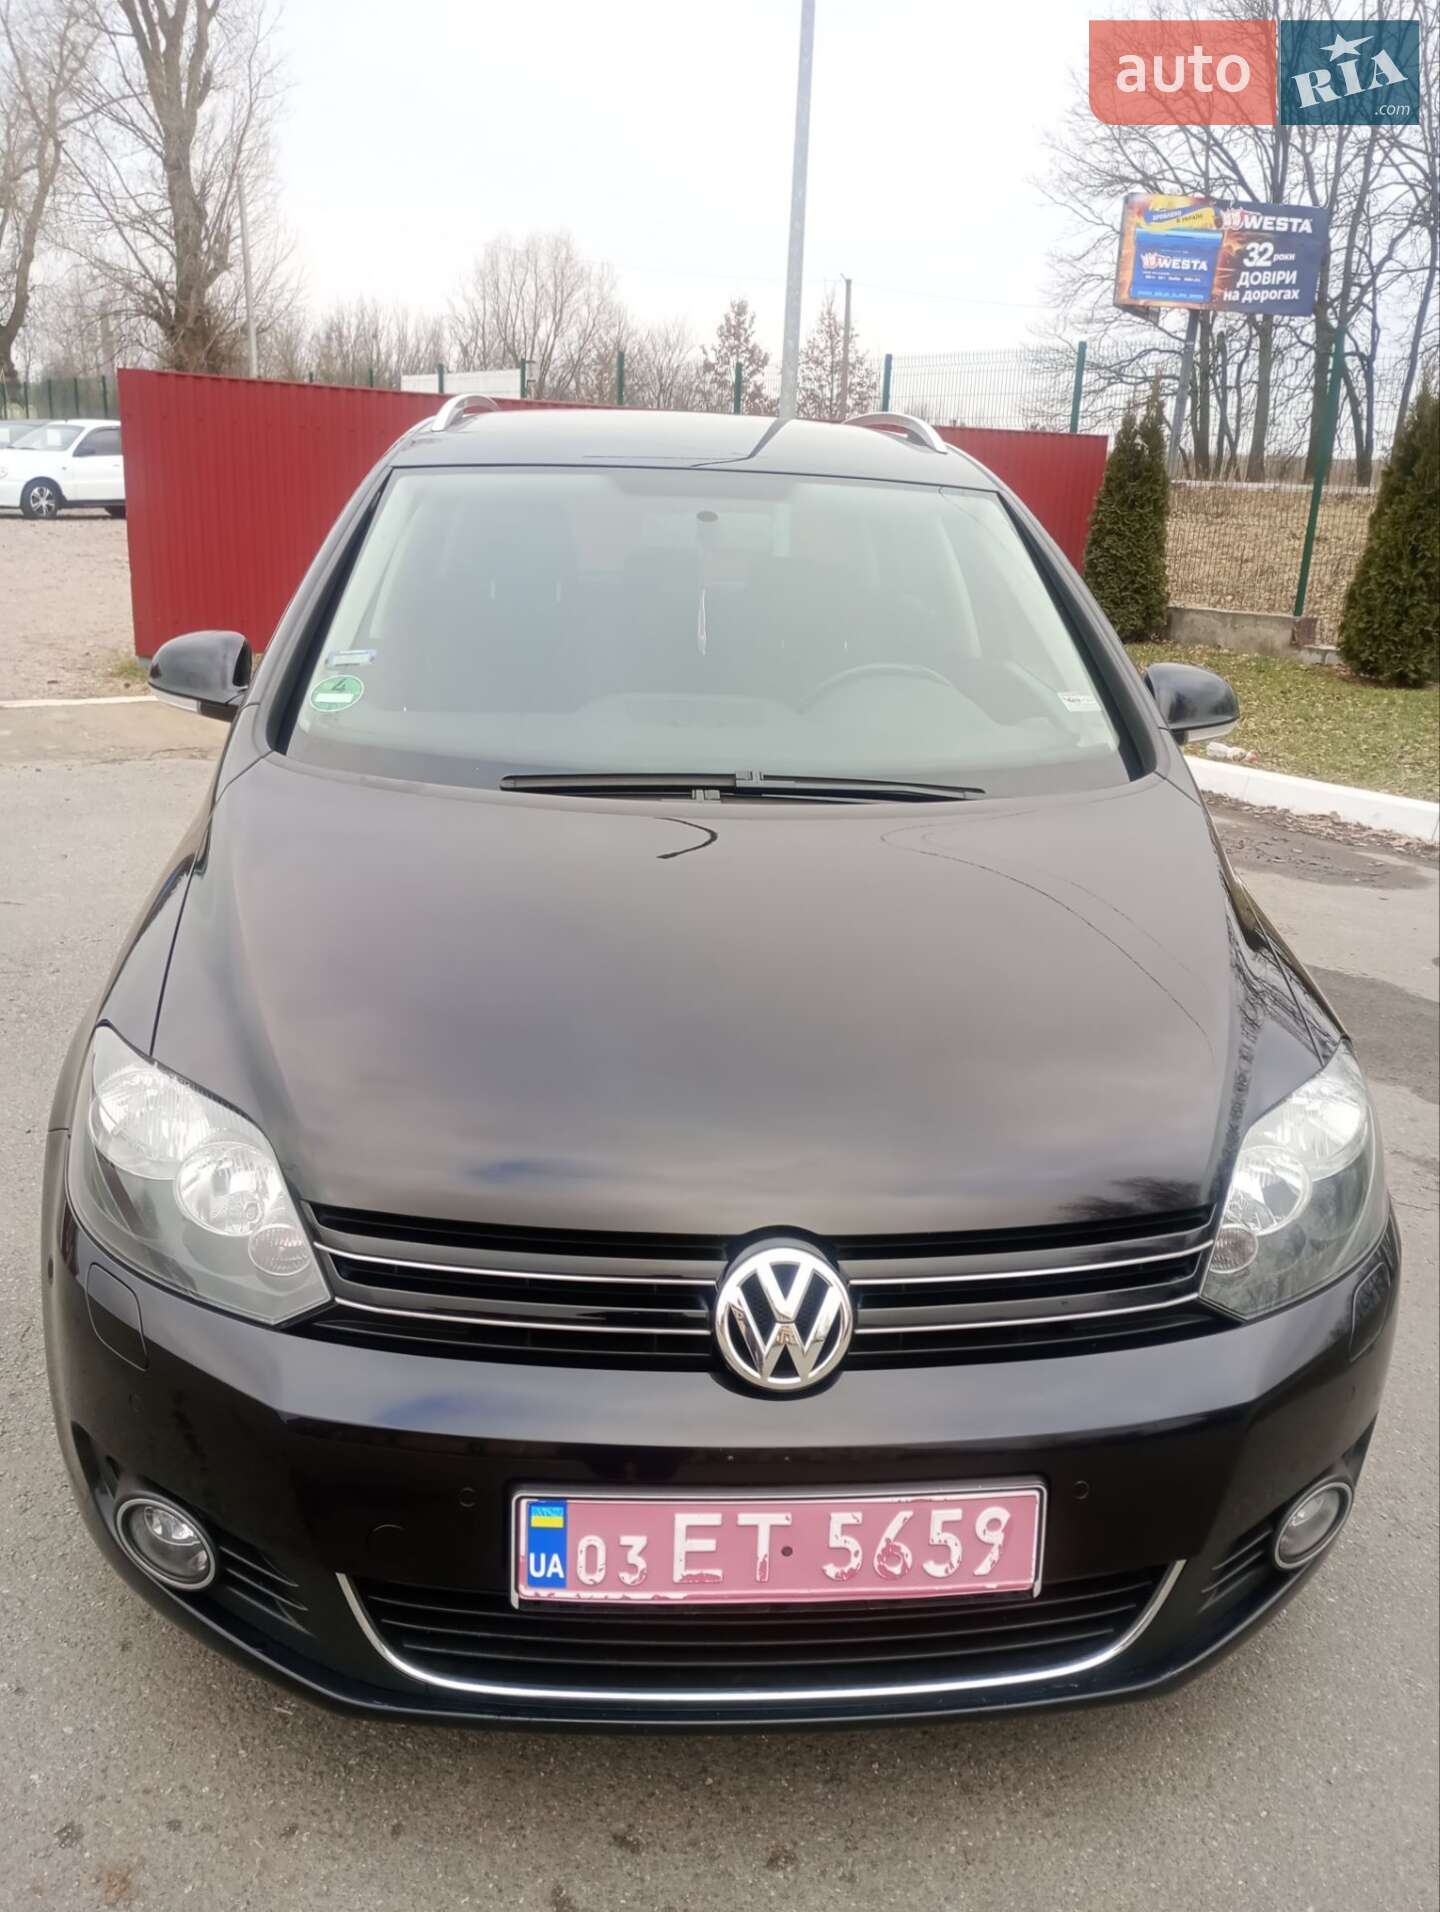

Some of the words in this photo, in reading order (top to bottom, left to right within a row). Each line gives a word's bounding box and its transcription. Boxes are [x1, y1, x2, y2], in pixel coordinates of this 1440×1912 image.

[1243, 214, 1313, 234] WESTA
[1158, 257, 1208, 271] WESTA
[1243, 241, 1274, 267] 32
[1236, 270, 1297, 288] ДОВІРИ
[1223, 289, 1239, 301] на
[1241, 288, 1300, 303] дорогах
[576, 1535, 649, 1585] 03
[673, 1513, 792, 1583] ET
[822, 1506, 1011, 1582] 5659
[529, 1553, 565, 1578] UA
